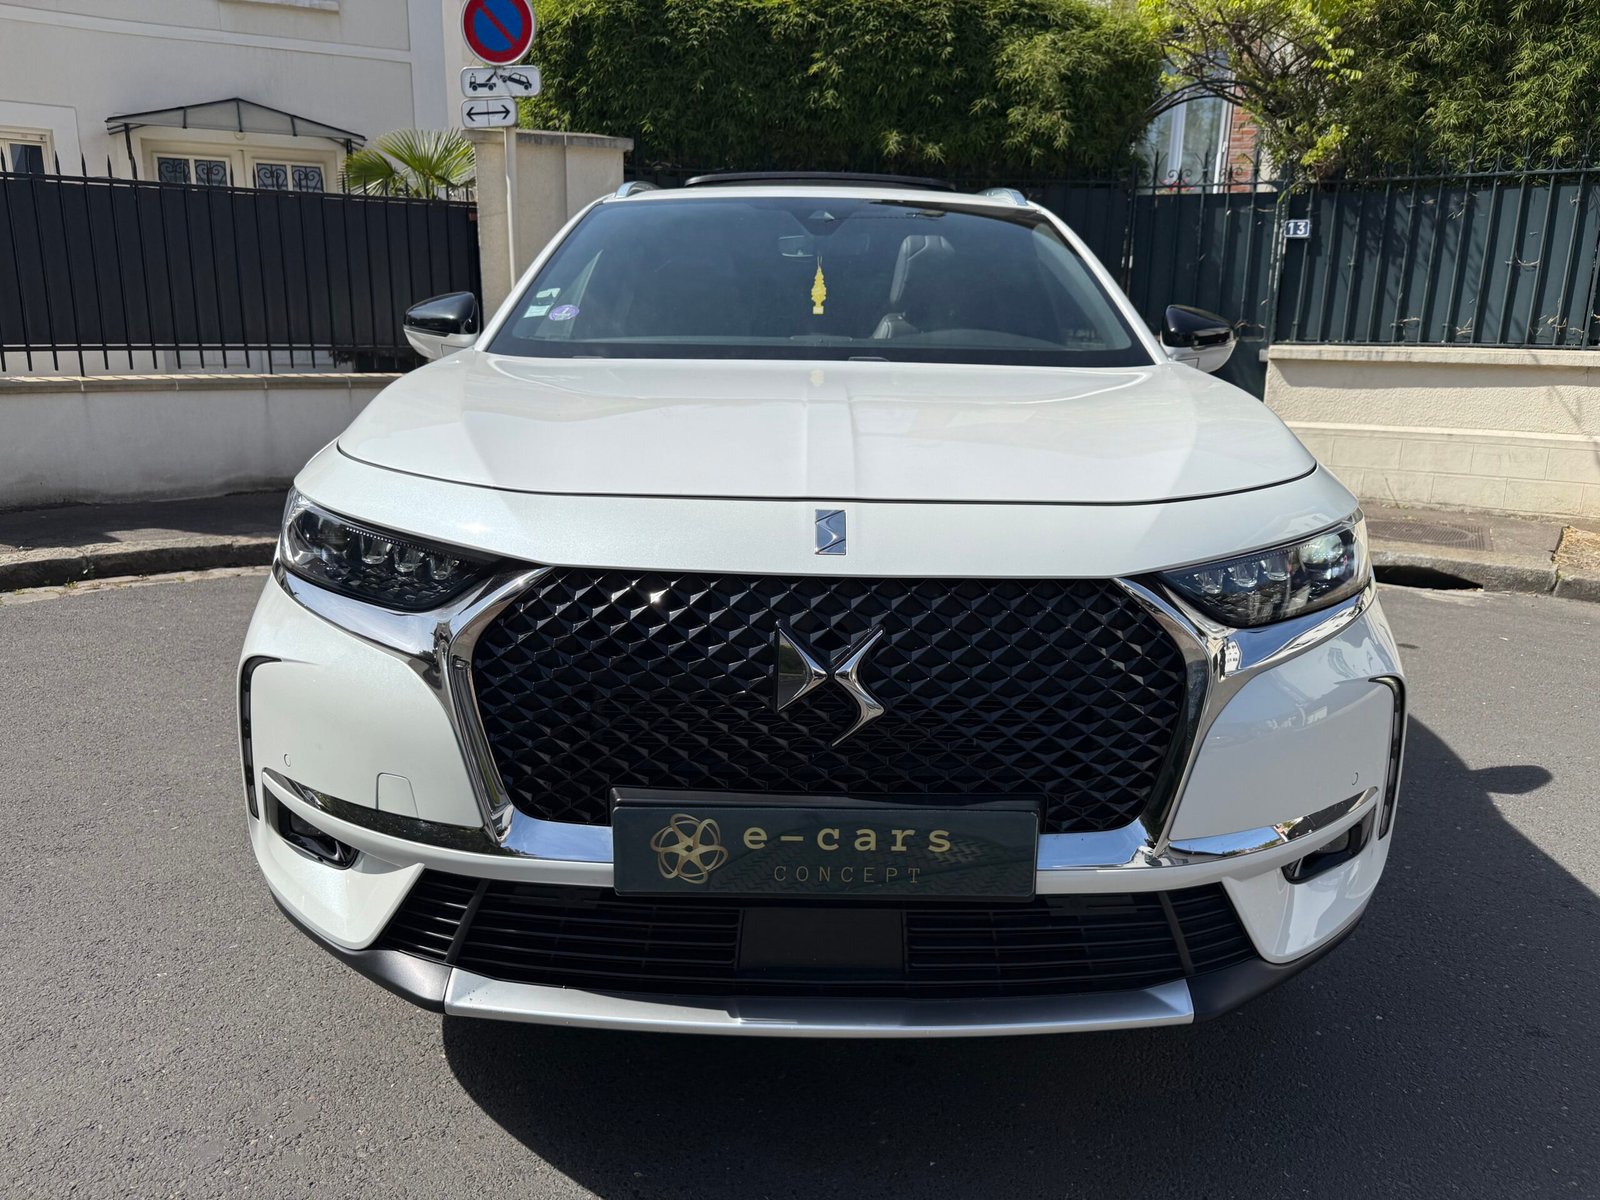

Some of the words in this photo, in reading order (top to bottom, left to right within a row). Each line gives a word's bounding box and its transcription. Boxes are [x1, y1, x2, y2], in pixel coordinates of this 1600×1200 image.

[1287, 222, 1306, 235] 13
[743, 826, 951, 852] e-cars
[773, 865, 921, 884] CONCEPT
